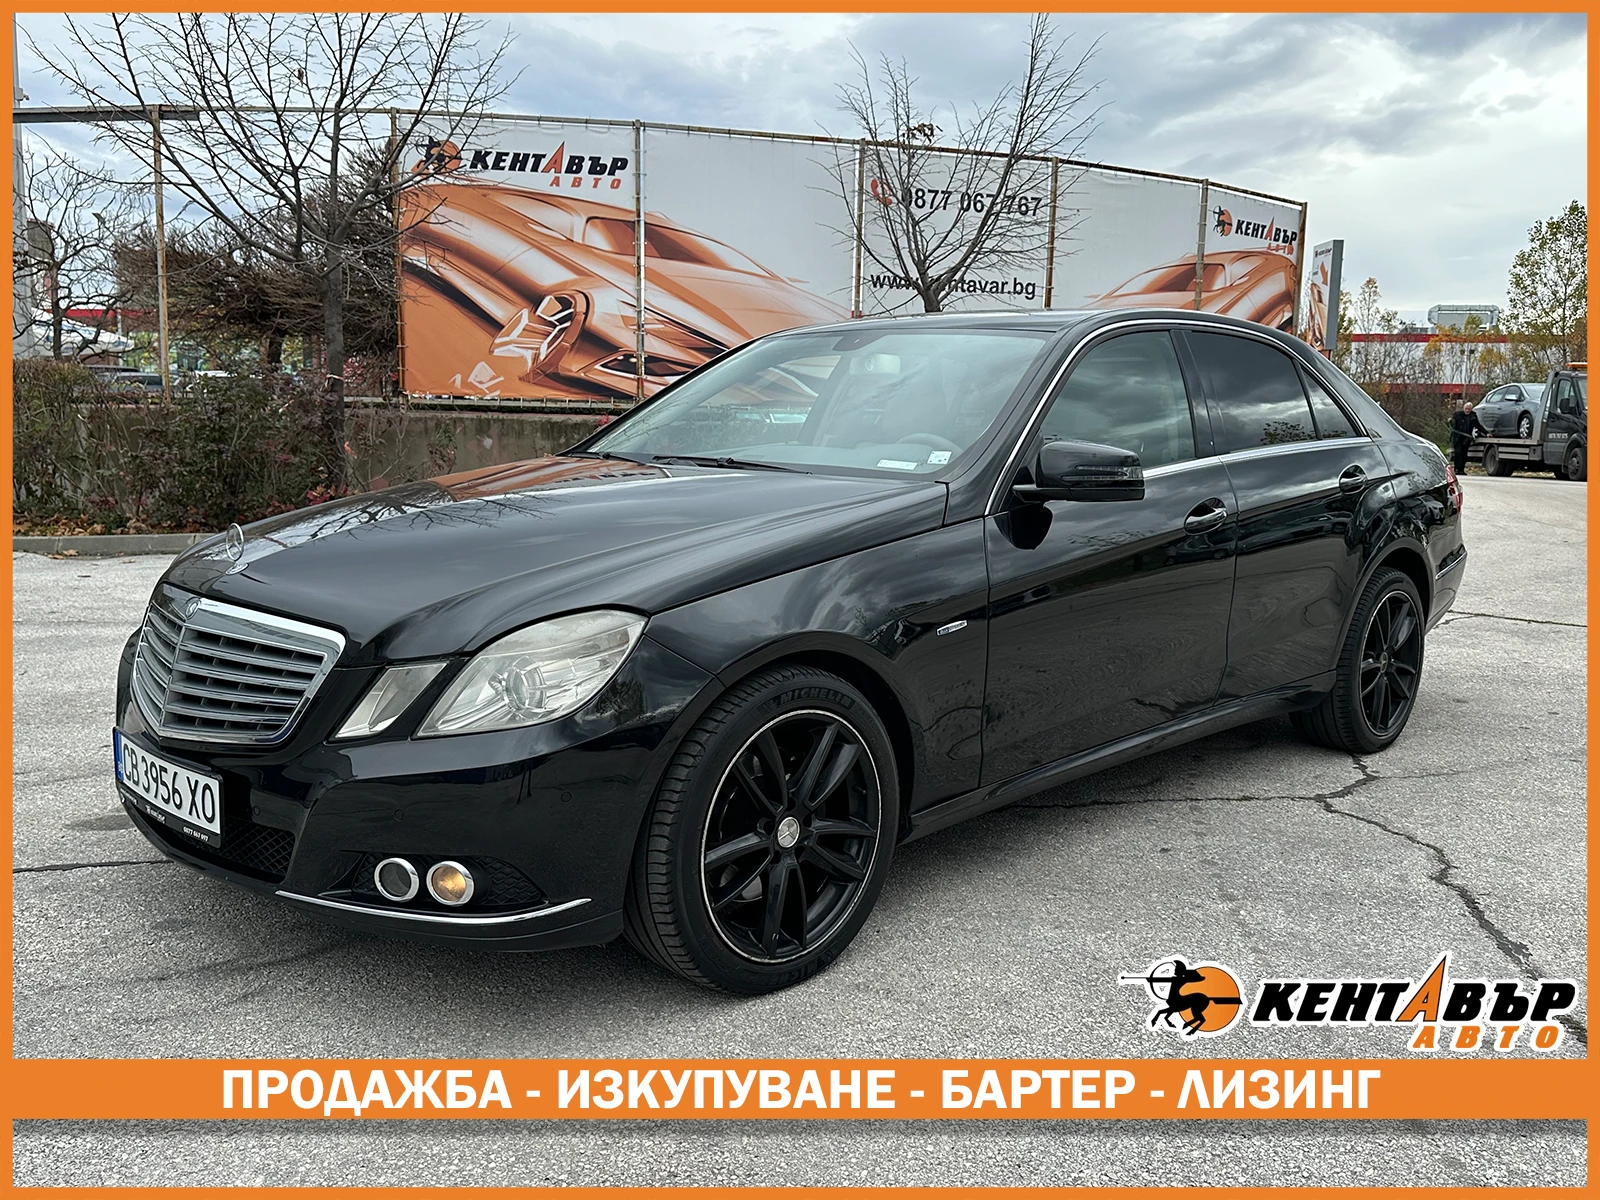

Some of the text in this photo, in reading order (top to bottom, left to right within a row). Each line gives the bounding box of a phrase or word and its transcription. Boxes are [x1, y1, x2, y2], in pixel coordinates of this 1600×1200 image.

[469, 141, 629, 177] КЕНТАВЪР
[550, 176, 622, 190] АВТО
[1235, 216, 1298, 246] КЕНТАВЪР
[870, 274, 1036, 301] wwwntavar.bg
[123, 743, 140, 787] CB
[141, 755, 183, 810] 3956
[186, 776, 215, 824] XO
